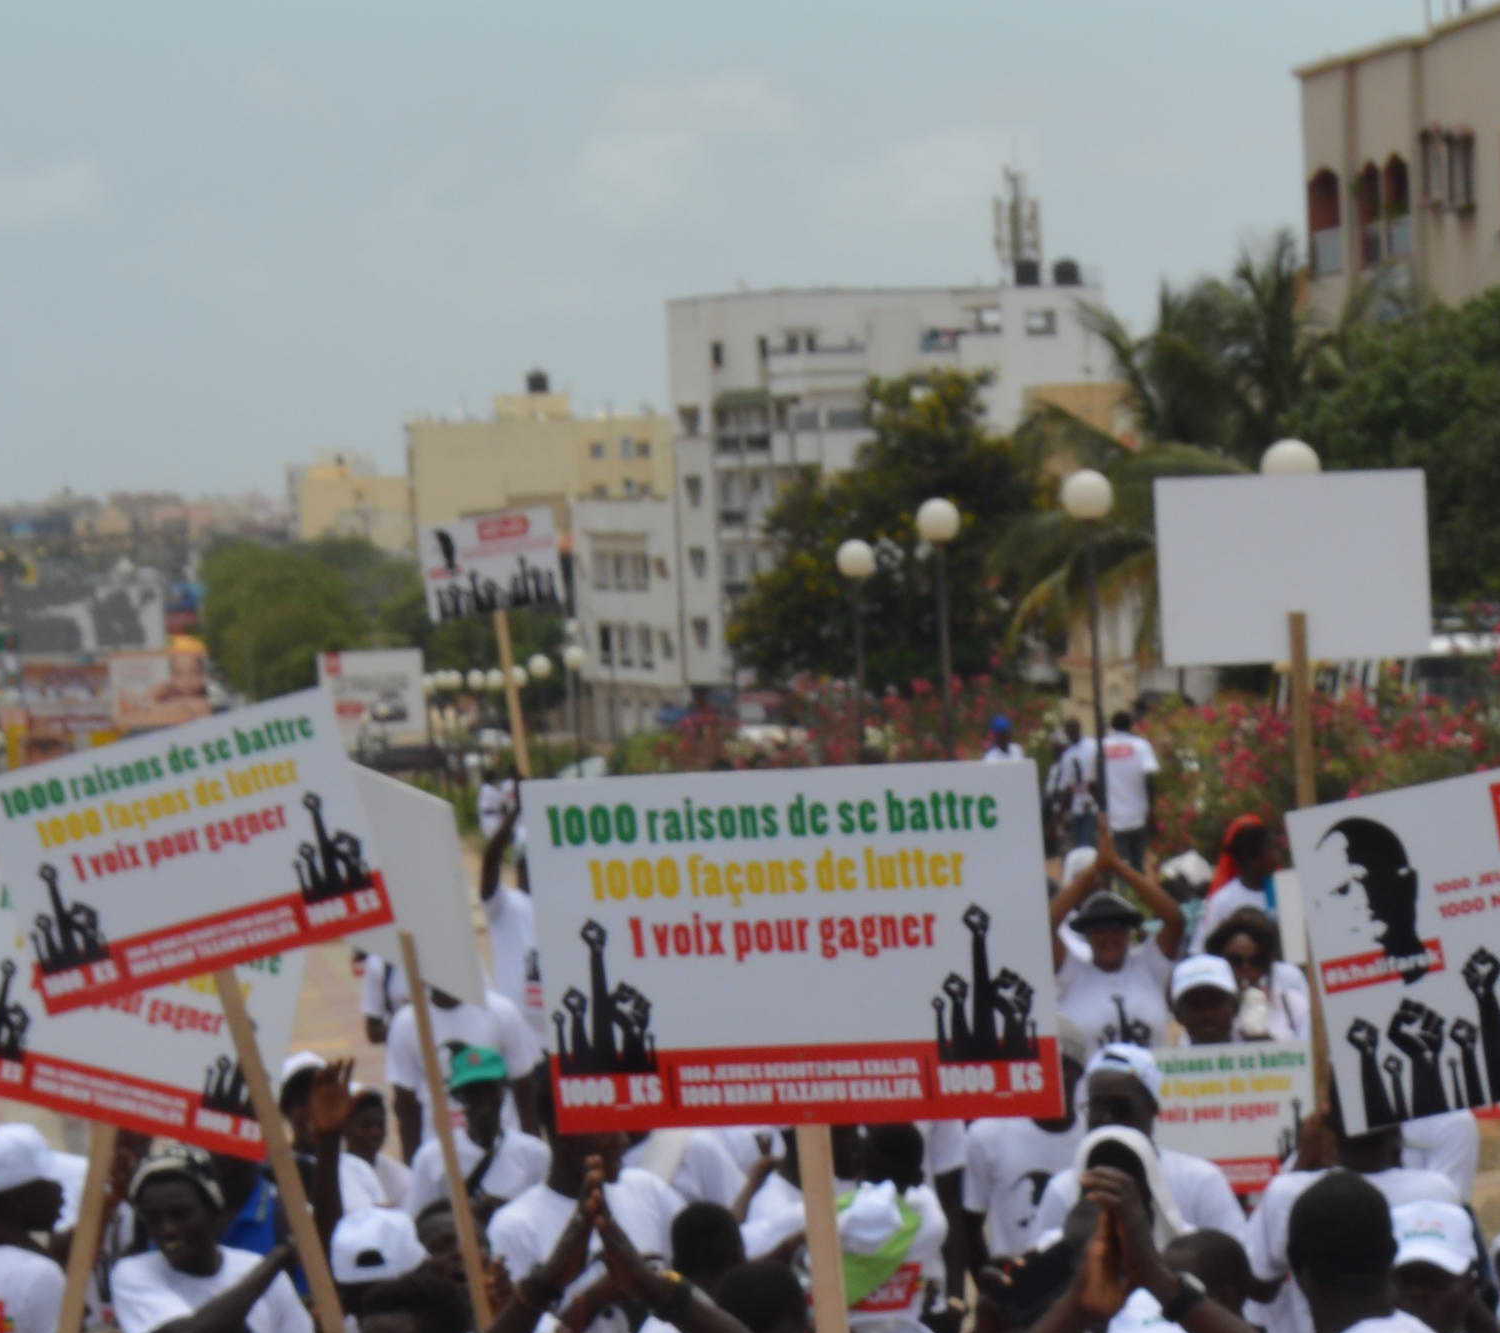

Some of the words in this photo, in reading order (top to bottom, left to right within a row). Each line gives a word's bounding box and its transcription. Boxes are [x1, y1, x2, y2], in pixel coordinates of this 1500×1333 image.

[0, 778, 66, 819] 1000
[68, 756, 164, 801] raisons
[167, 745, 198, 774] de
[202, 739, 233, 765] se
[233, 715, 314, 754] battre
[546, 803, 638, 848] 1000
[646, 796, 780, 844] raisons
[787, 792, 831, 837] de
[836, 799, 878, 835] se
[885, 789, 999, 832] battre
[89, 838, 142, 879] voix
[146, 828, 198, 870] pour
[587, 855, 681, 901] 1000
[687, 853, 808, 907] façons
[814, 849, 858, 892] de
[863, 846, 965, 890] lutter
[1434, 876, 1472, 894] 1000
[1439, 897, 1486, 919] 1000
[652, 911, 725, 957] voix
[734, 914, 810, 962] pour
[818, 911, 937, 960] gagner
[559, 1075, 664, 1110] 1000_KS
[937, 1062, 1045, 1097] 1000_KS
